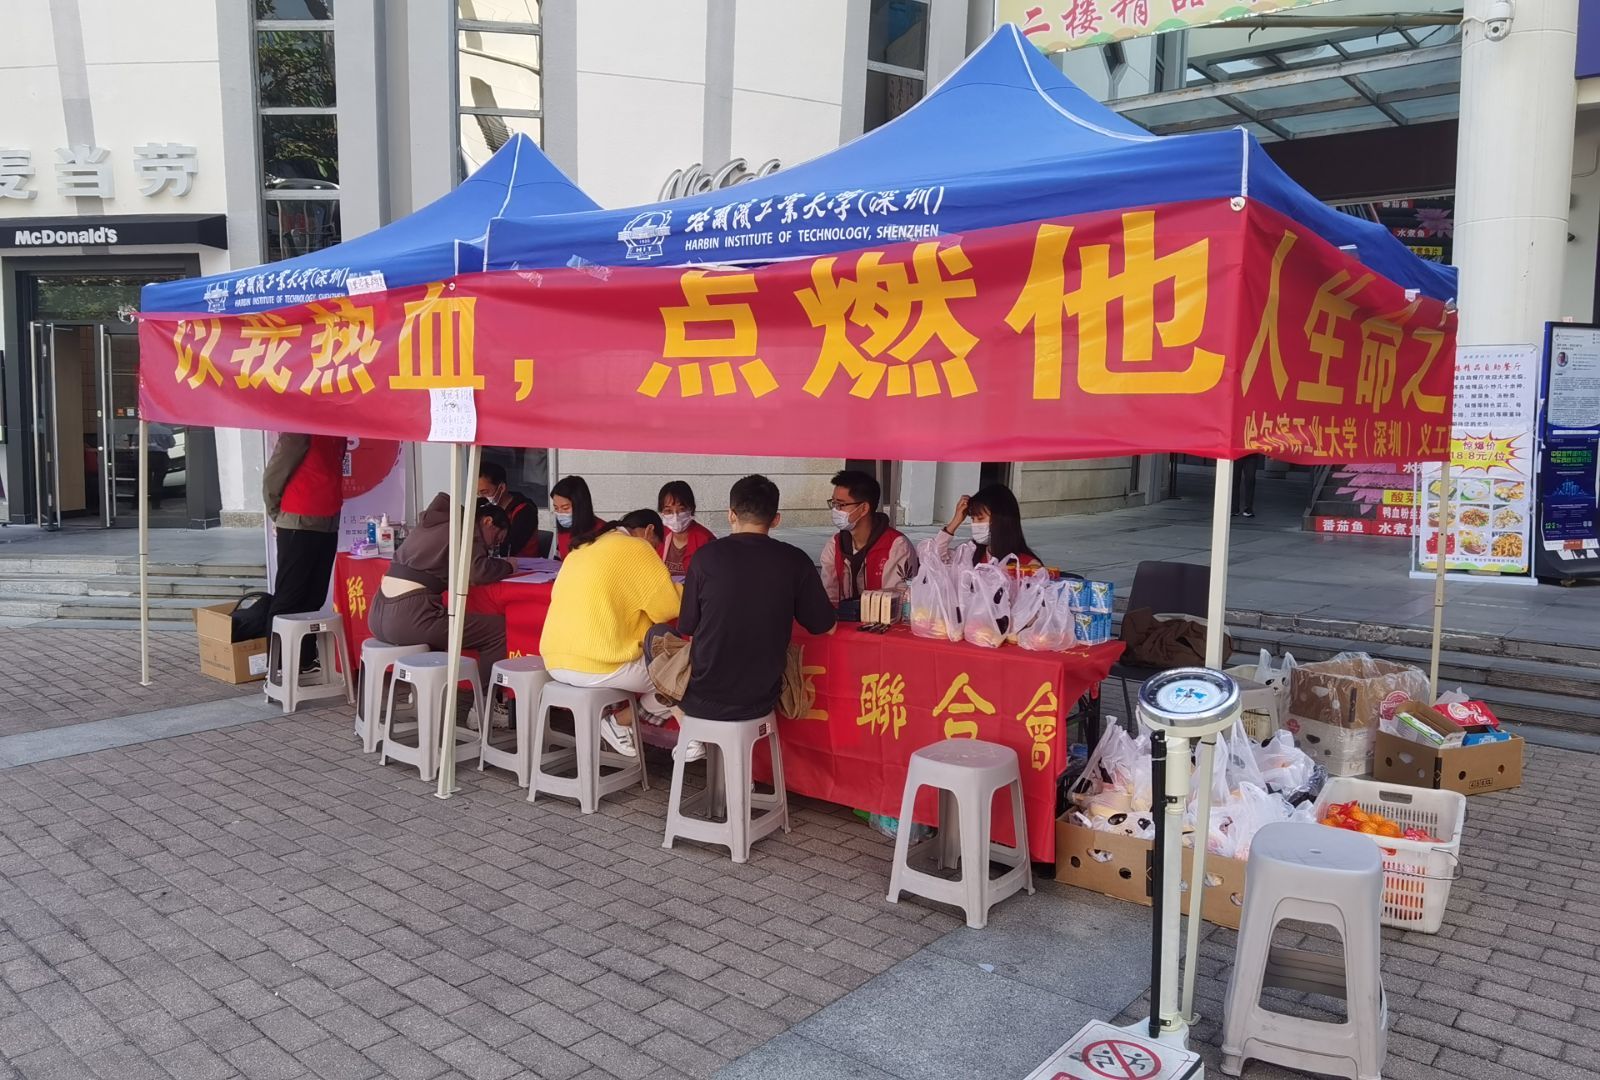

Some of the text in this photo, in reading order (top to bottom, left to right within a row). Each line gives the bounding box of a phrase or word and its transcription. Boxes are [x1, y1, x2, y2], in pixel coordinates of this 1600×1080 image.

[14, 226, 118, 246] McDonald's
[684, 222, 939, 251] HARBIN INSTITUTE OF TECHNOLOGY, SHENZHEN
[1397, 229, 1425, 238] 水煮鱼
[234, 299, 251, 307] HARBIN
[252, 296, 274, 306] INSTITUTE
[276, 295, 283, 303] OF
[637, 210, 1225, 400] 点燃他
[1240, 229, 1447, 414] 人生命之
[1243, 409, 1451, 458] 哈尔滨工业大学(深圳)义工
[1463, 441, 1496, 450] 惊爆价
[1323, 519, 1364, 533] 番茄鱼
